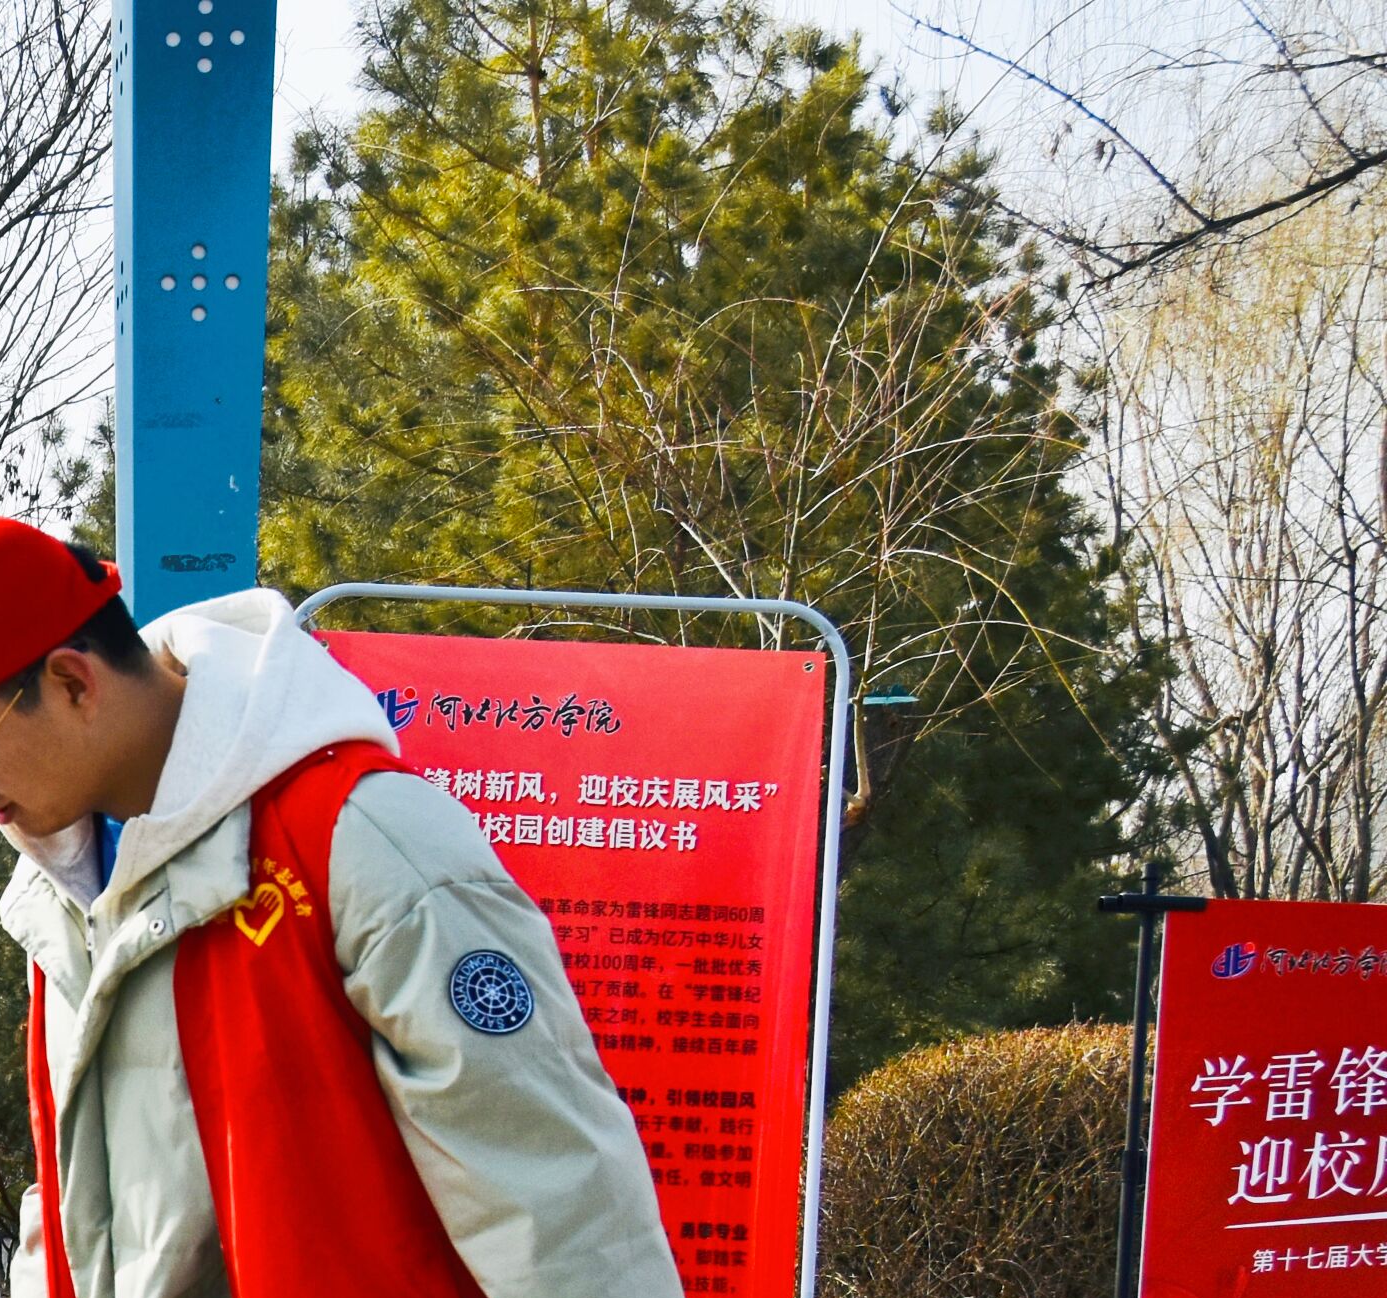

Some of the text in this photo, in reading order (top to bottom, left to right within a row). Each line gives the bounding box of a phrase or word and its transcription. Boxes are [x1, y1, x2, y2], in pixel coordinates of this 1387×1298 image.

[426, 691, 621, 737] 河北北方学院
[470, 812, 698, 853] 校园创建倡议书
[581, 1007, 760, 1030] 庆之时，校学生会面向
[1189, 1045, 1387, 1127] 学雷锋
